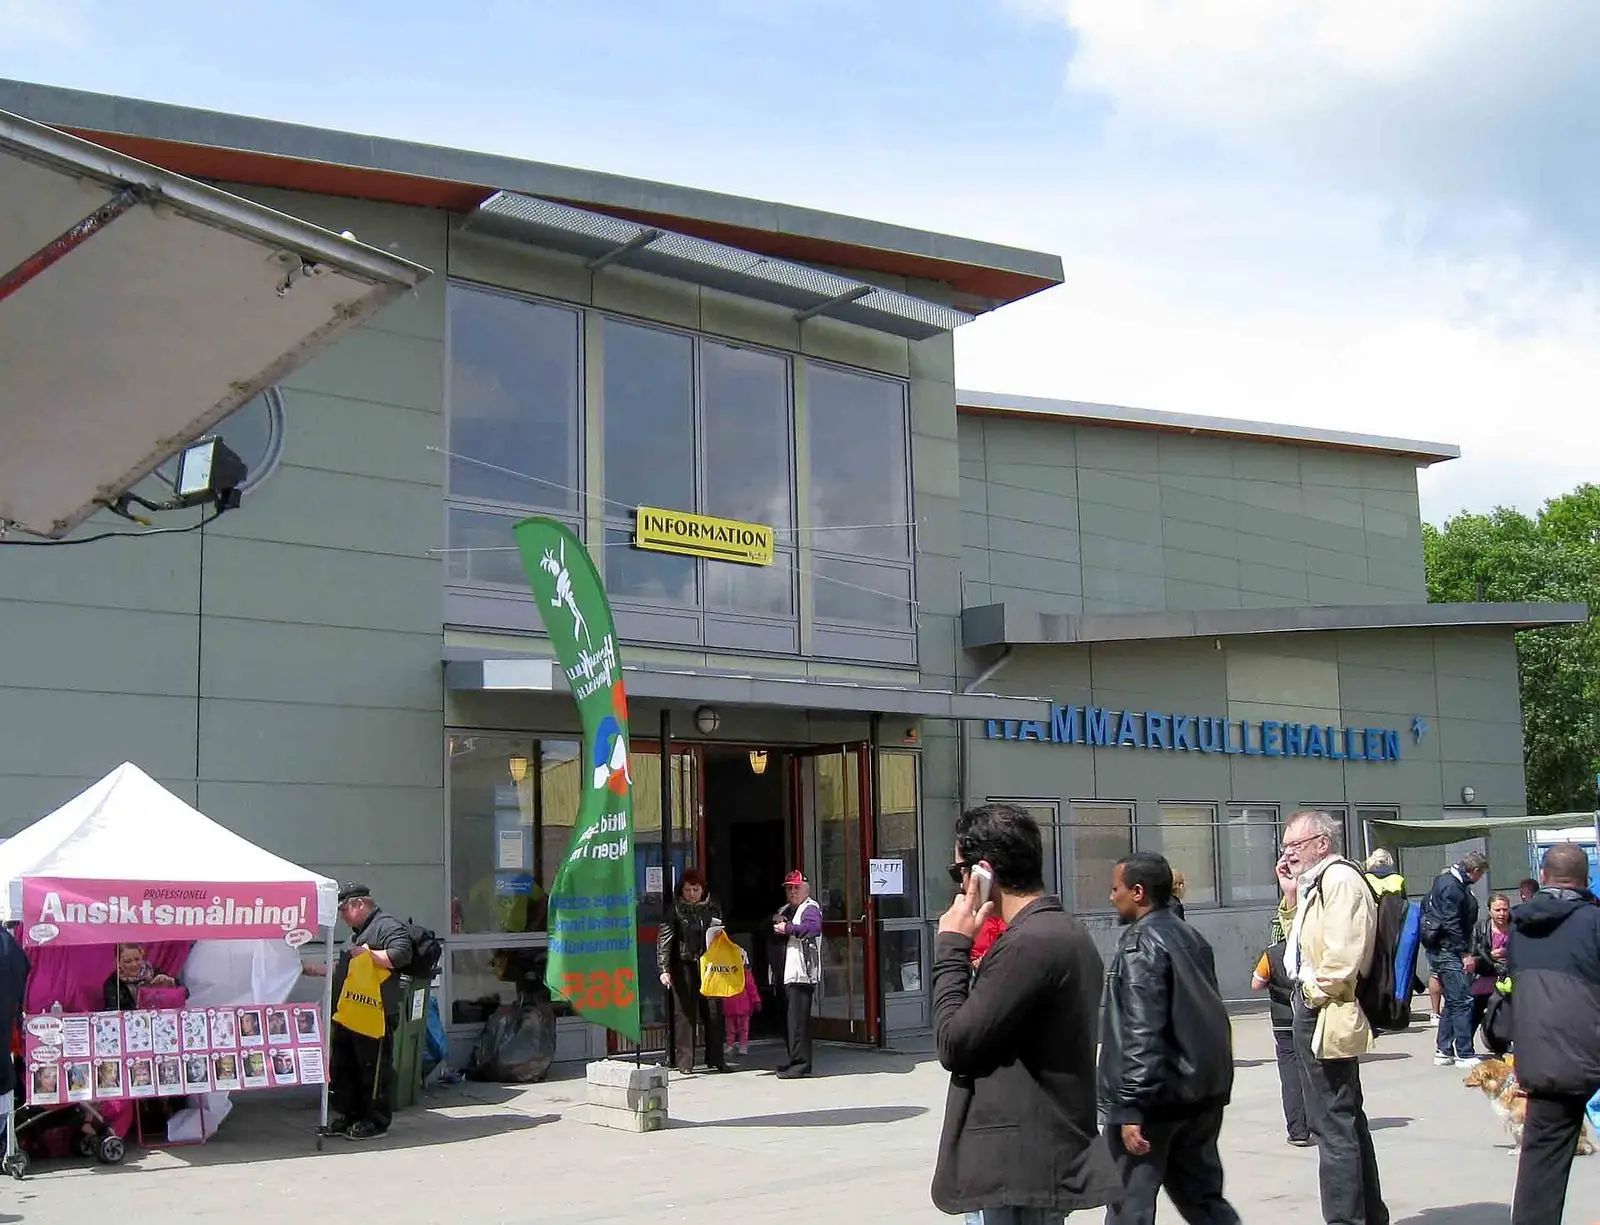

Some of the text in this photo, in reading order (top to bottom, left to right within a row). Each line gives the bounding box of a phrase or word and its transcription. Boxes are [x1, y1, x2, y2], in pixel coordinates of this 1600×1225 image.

[643, 513, 767, 548] INFORMATION
[39, 892, 306, 931] Ansiktsmålning!
[344, 990, 378, 1007] FOREX
